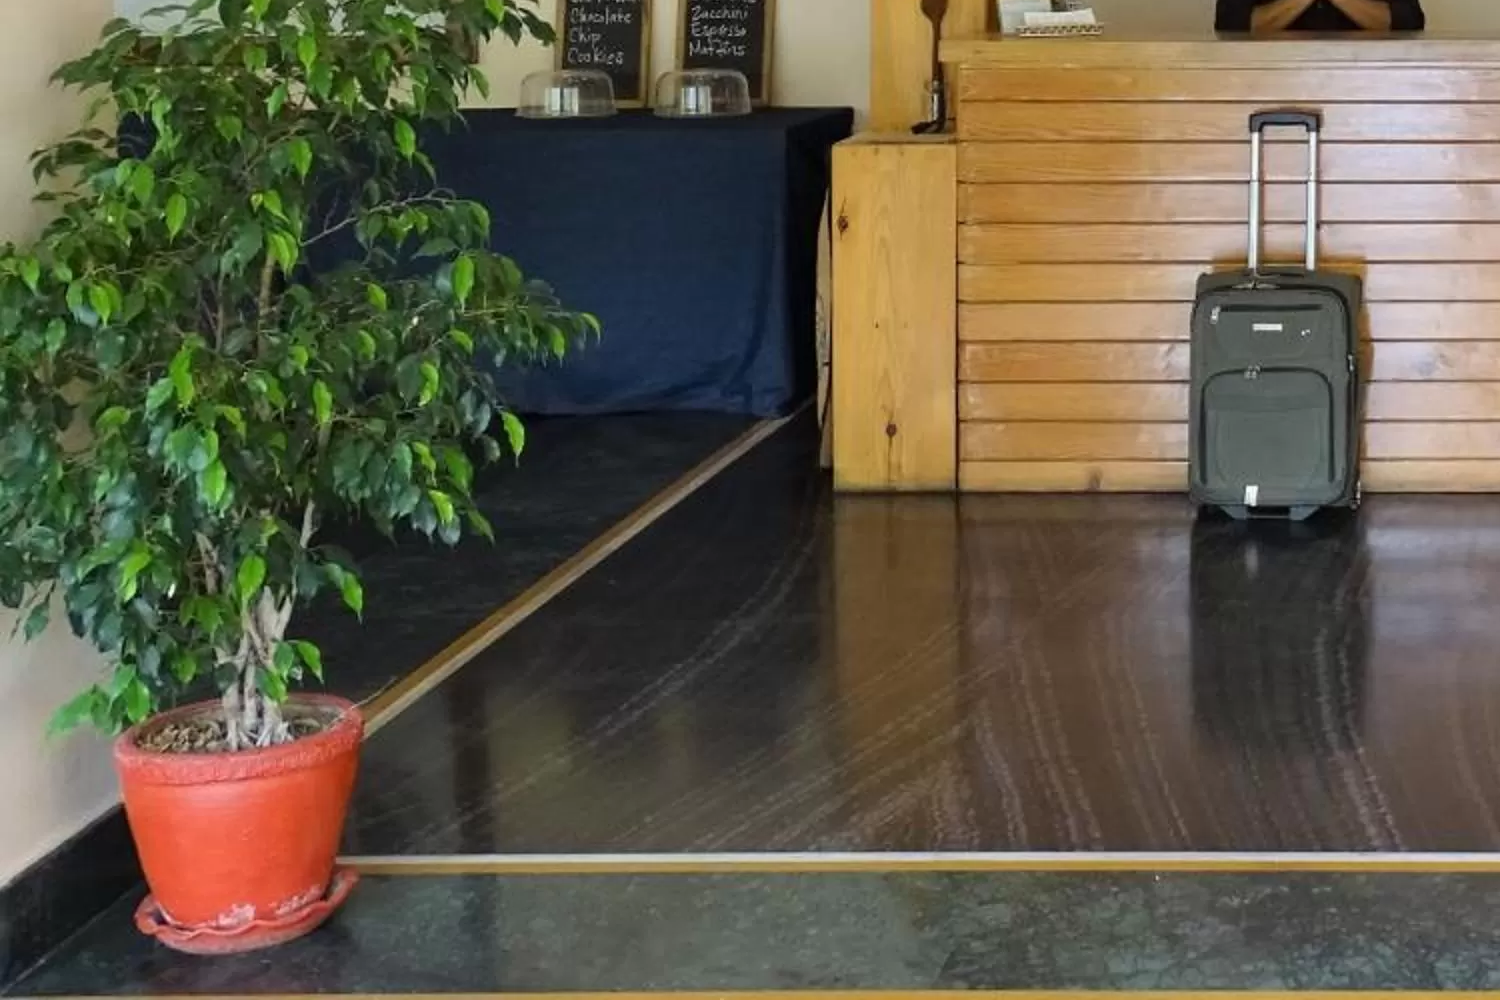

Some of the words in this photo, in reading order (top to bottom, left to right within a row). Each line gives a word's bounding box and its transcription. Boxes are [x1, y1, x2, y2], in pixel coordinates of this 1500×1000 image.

[569, 4, 633, 25] Chocolate
[569, 25, 602, 48] Chip
[568, 46, 625, 65] Cookies
